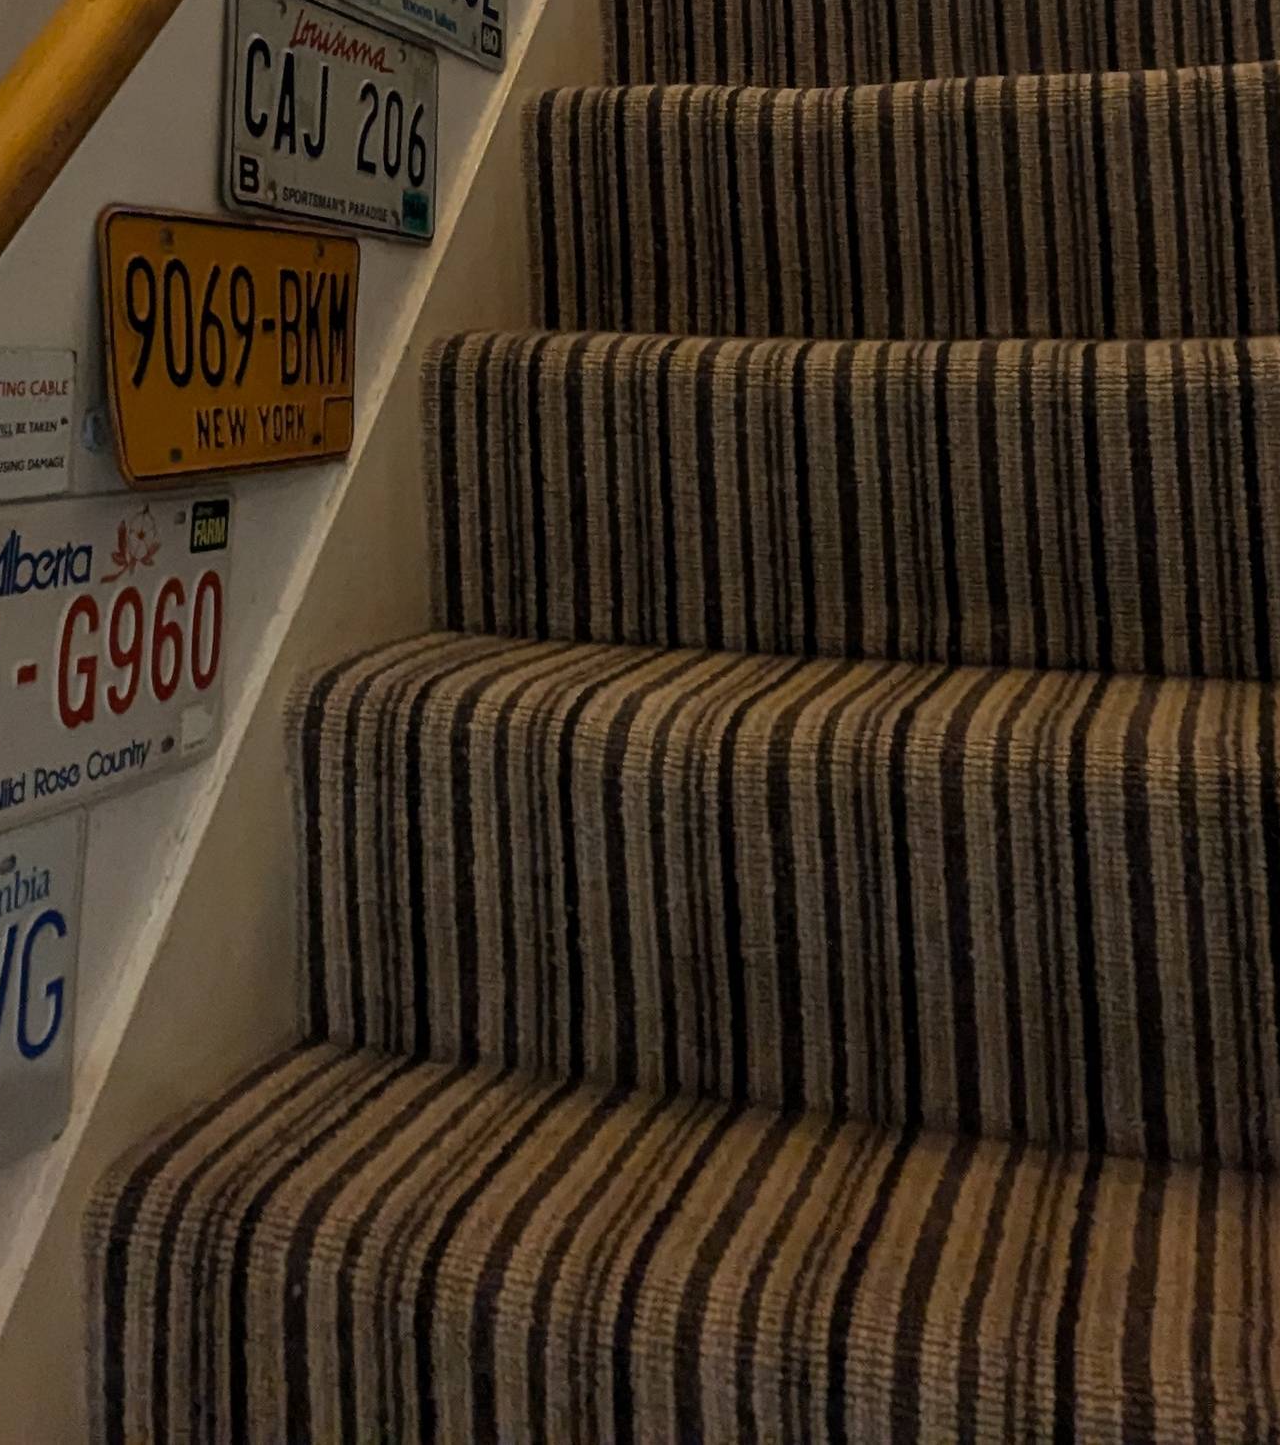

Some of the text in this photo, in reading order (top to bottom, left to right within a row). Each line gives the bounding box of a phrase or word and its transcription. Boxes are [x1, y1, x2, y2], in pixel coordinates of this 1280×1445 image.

[289, 9, 393, 73] Louisiana
[244, 38, 426, 187] CAJ 206
[238, 154, 259, 193] B
[282, 186, 345, 214] SPORTSMAN'S
[347, 201, 387, 222] PARADISE
[123, 255, 350, 390] 9069-BKM
[30, 379, 69, 398] CABLE
[16, 420, 29, 435] BE
[29, 419, 58, 434] TAKEN
[196, 404, 307, 449] NEW YORK
[27, 456, 65, 474] DAMAGE
[193, 514, 227, 548] FARM
[33, 764, 81, 800] Rose
[86, 737, 152, 780] Country
